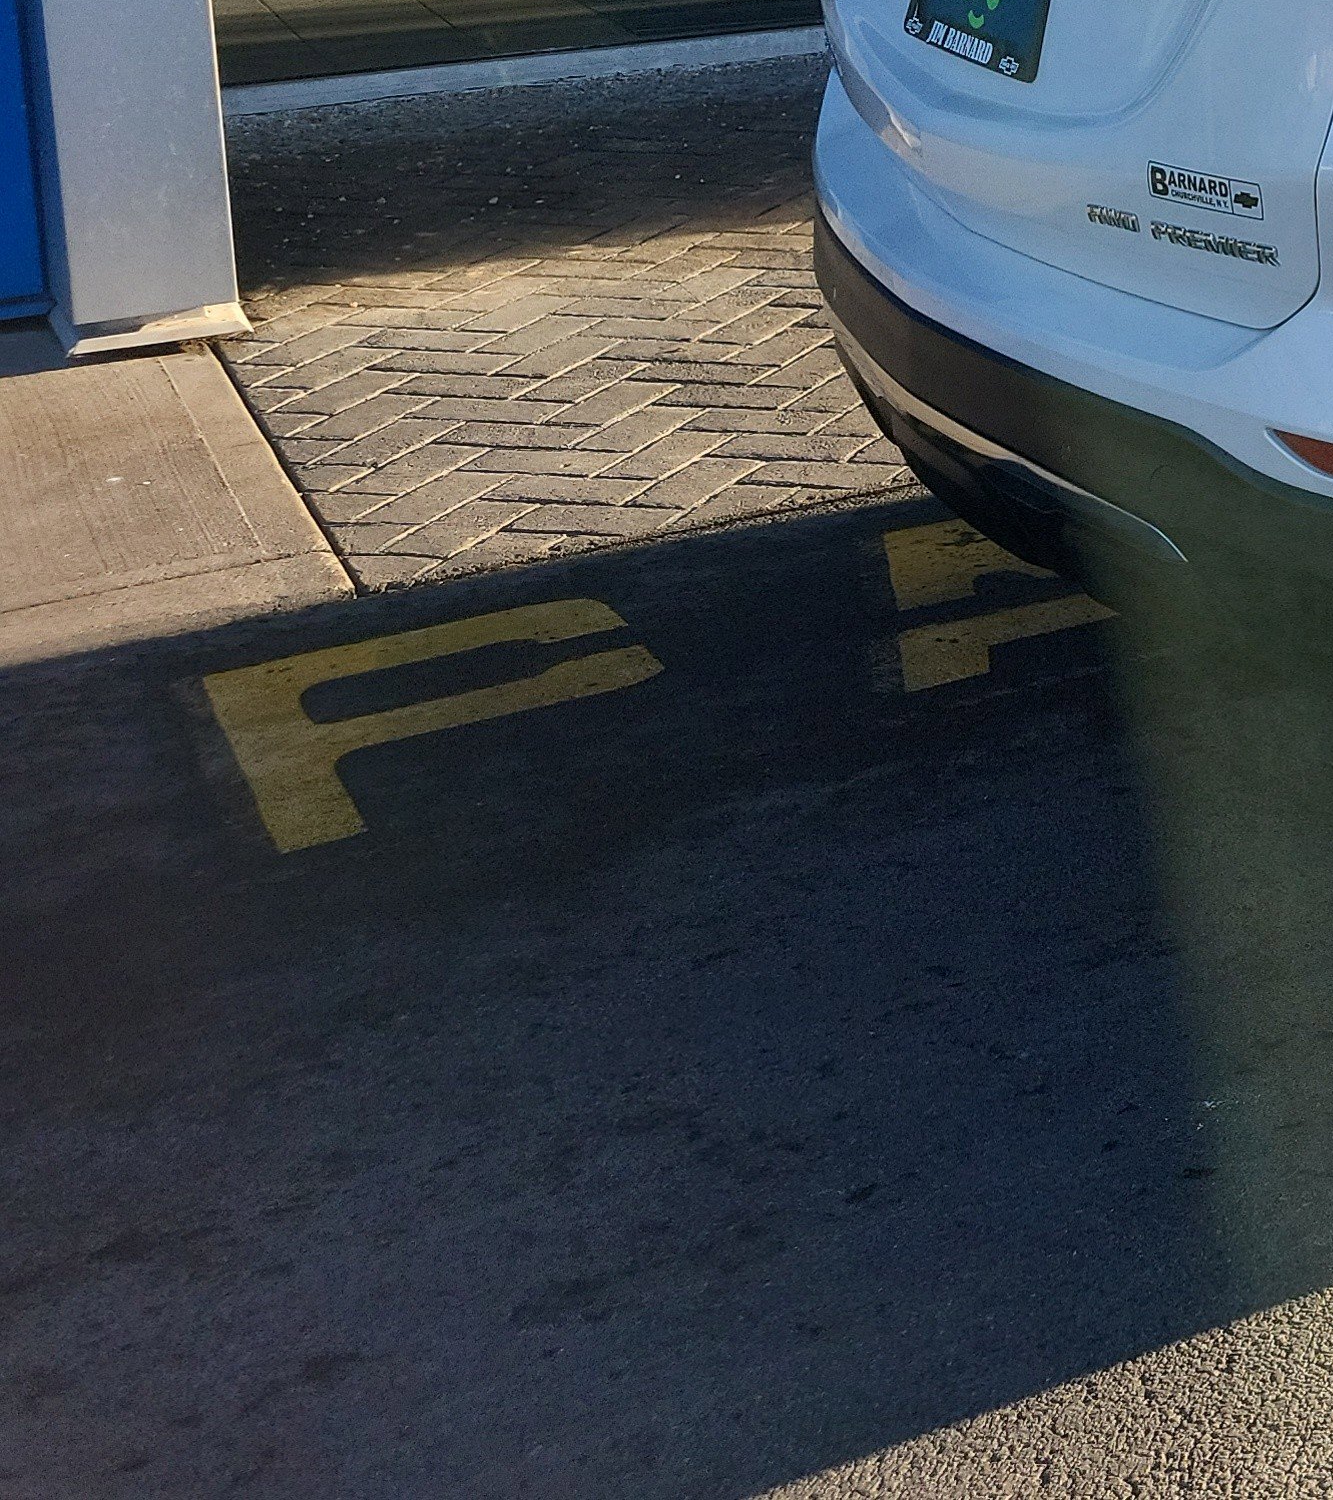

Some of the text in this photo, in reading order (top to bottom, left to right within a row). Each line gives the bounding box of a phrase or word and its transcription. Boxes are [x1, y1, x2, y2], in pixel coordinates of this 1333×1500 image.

[927, 20, 994, 64] JIM BARNARD
[1150, 164, 1229, 199] BARNARD
[1150, 220, 1282, 268] PREMIER
